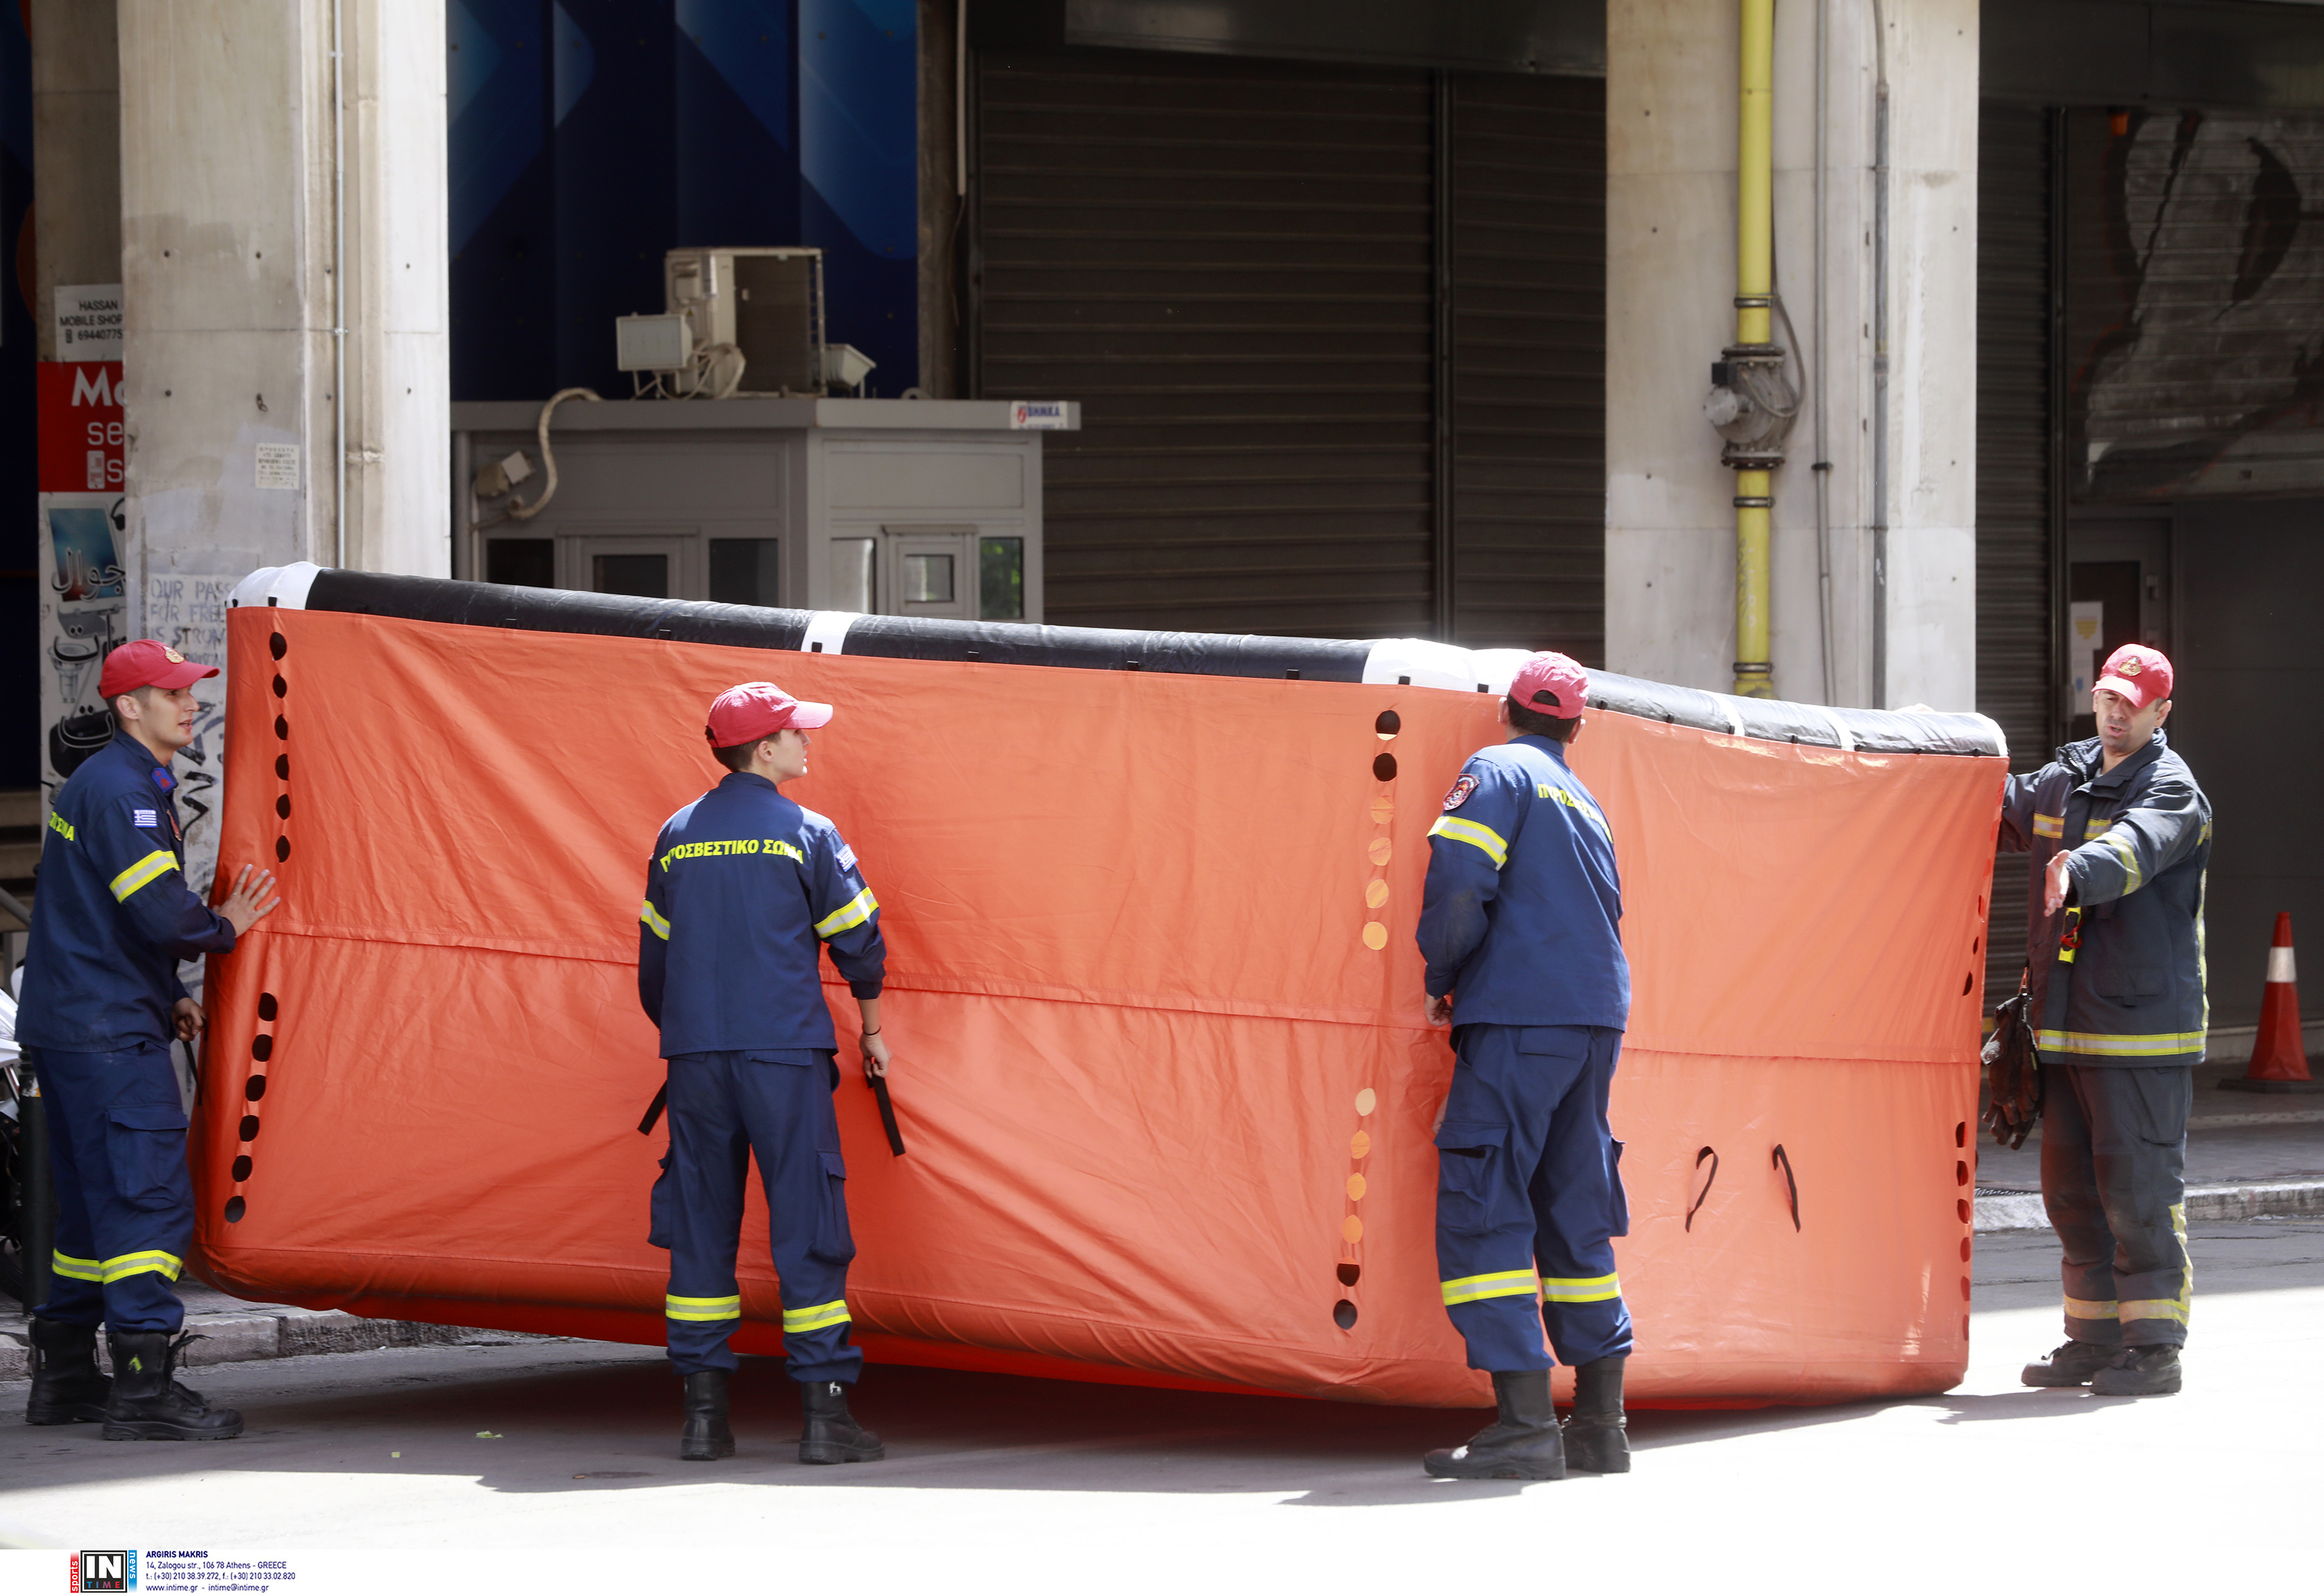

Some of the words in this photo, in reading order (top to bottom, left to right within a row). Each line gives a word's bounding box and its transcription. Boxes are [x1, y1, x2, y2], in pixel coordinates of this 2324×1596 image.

[79, 300, 118, 311] HASSAN
[60, 316, 95, 326] MOBILE
[151, 579, 184, 600] OUR
[150, 604, 179, 623] FOR
